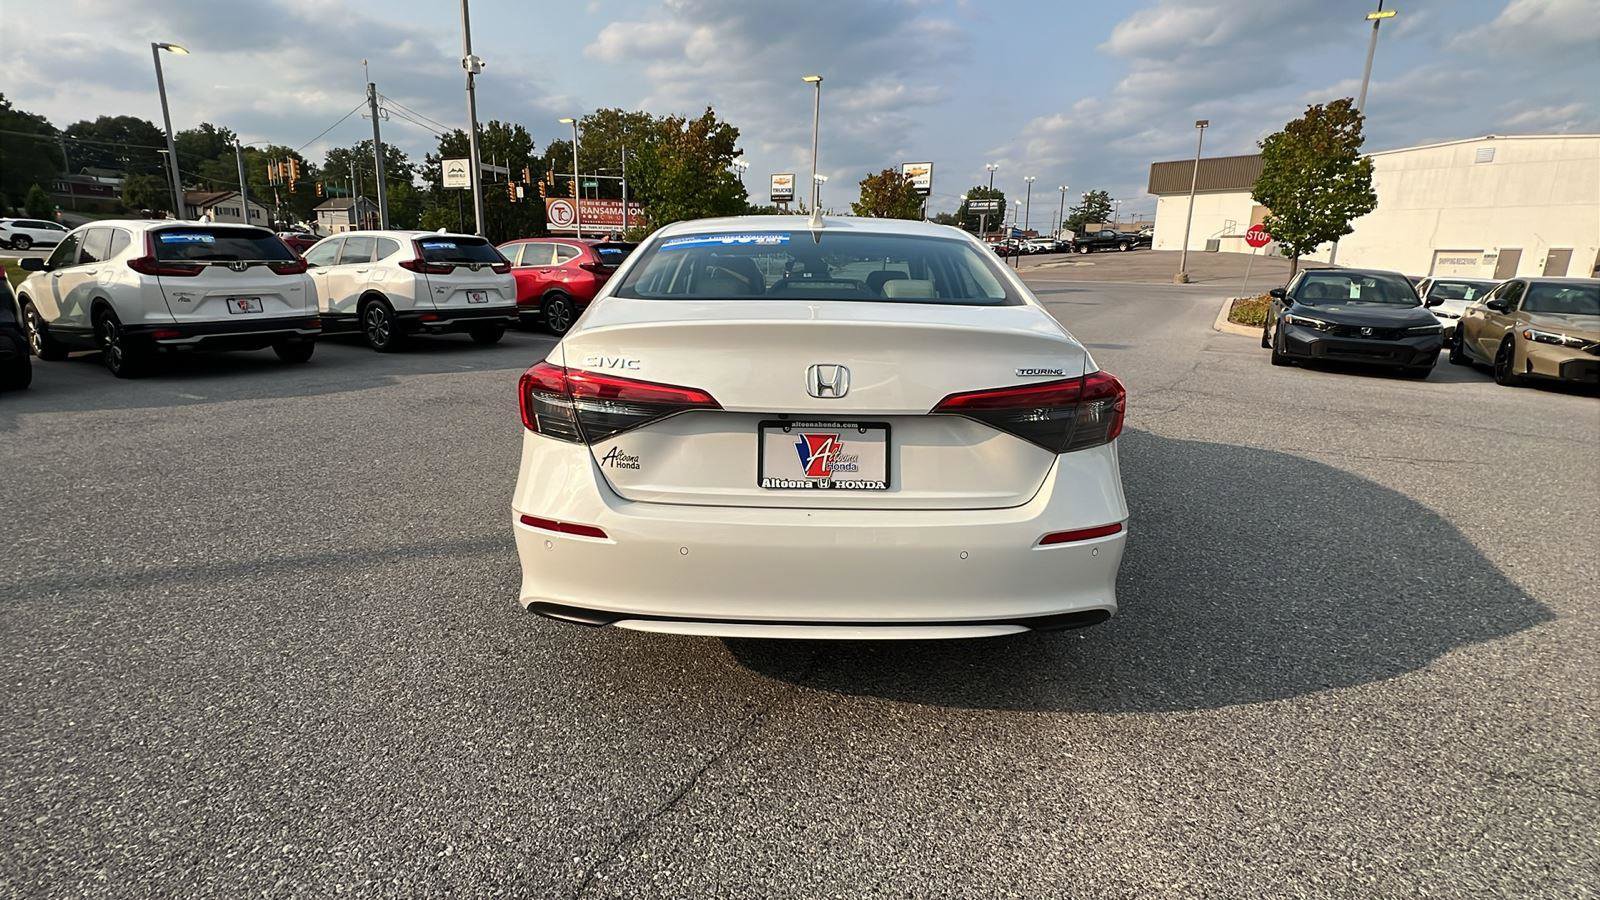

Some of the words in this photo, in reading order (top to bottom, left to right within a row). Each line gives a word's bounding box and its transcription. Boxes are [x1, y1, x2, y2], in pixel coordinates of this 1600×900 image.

[1246, 231, 1270, 241] STOP
[585, 356, 640, 370] CIVIC
[791, 421, 859, 429] altoonahonda.com
[601, 446, 640, 468] Altoona
[805, 437, 858, 472] Altoona
[616, 461, 641, 470] Honda
[826, 462, 858, 472] Honda
[762, 478, 813, 489] Altoona
[835, 480, 887, 489] HONDA
